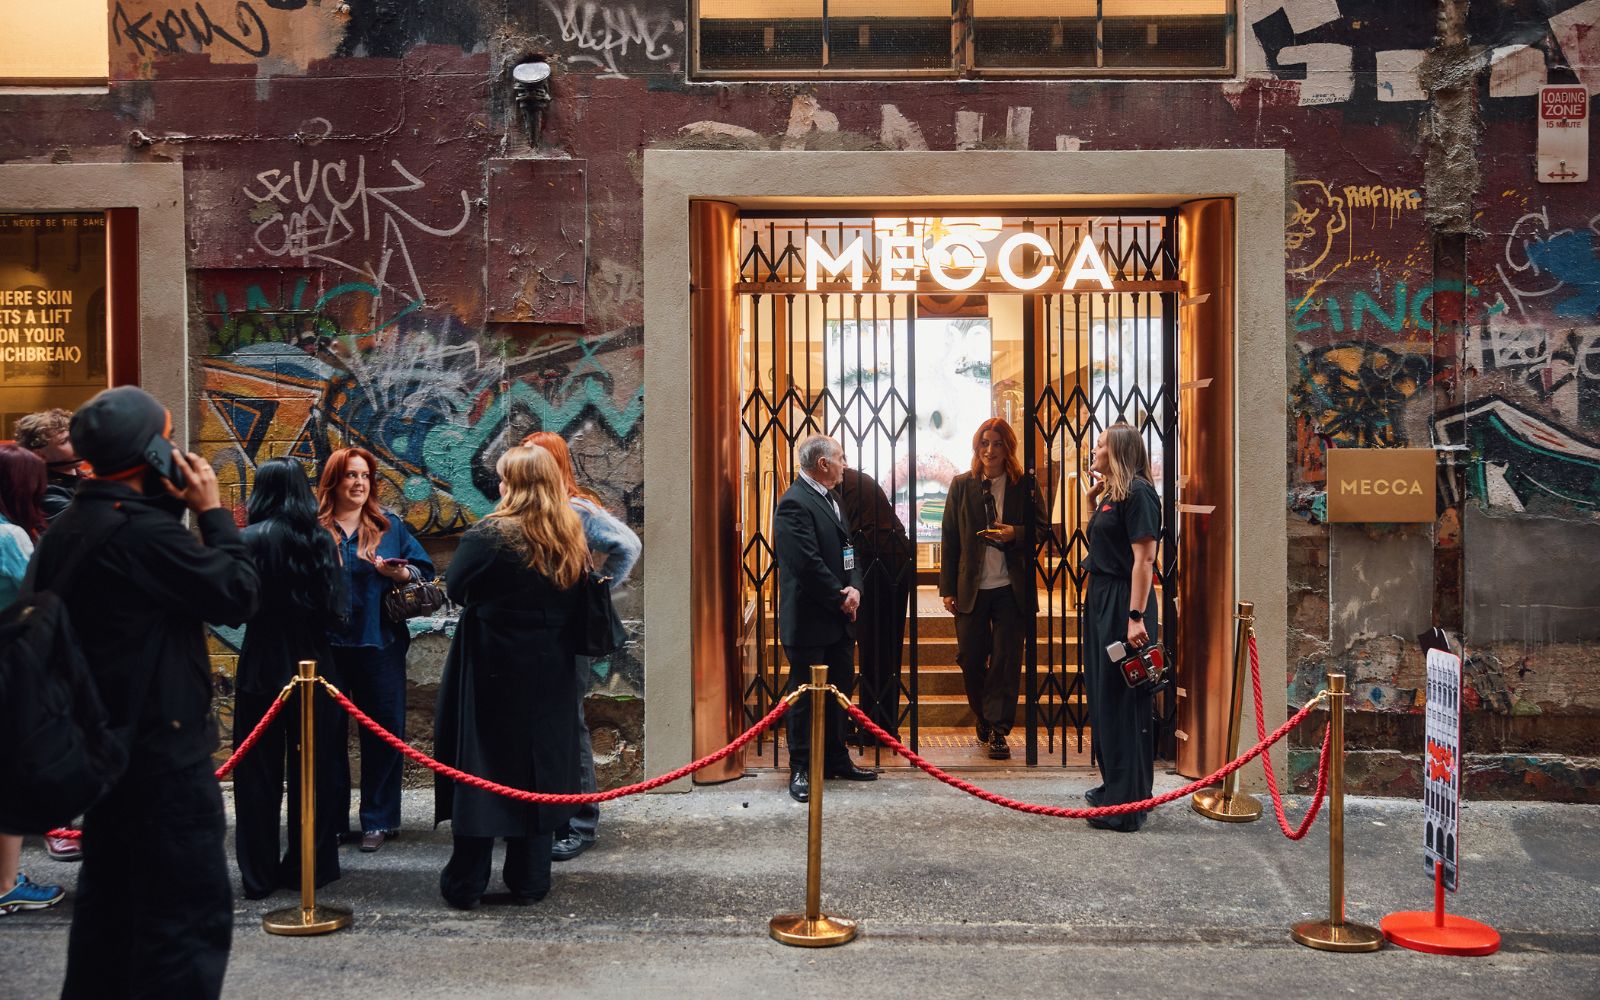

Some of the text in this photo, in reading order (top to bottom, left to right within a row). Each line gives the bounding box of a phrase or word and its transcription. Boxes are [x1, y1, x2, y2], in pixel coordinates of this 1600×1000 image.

[1543, 92, 1585, 103] LOADING
[1545, 104, 1582, 116] ZONE
[45, 219, 57, 227] BE
[61, 218, 78, 227] THE
[83, 218, 105, 226] SAME
[805, 232, 1115, 291] MECCA
[37, 290, 72, 305] SKIN
[25, 309, 37, 324] A
[41, 308, 73, 324] LIFT
[23, 327, 65, 343] YOUR
[1340, 478, 1423, 495] MECCA
